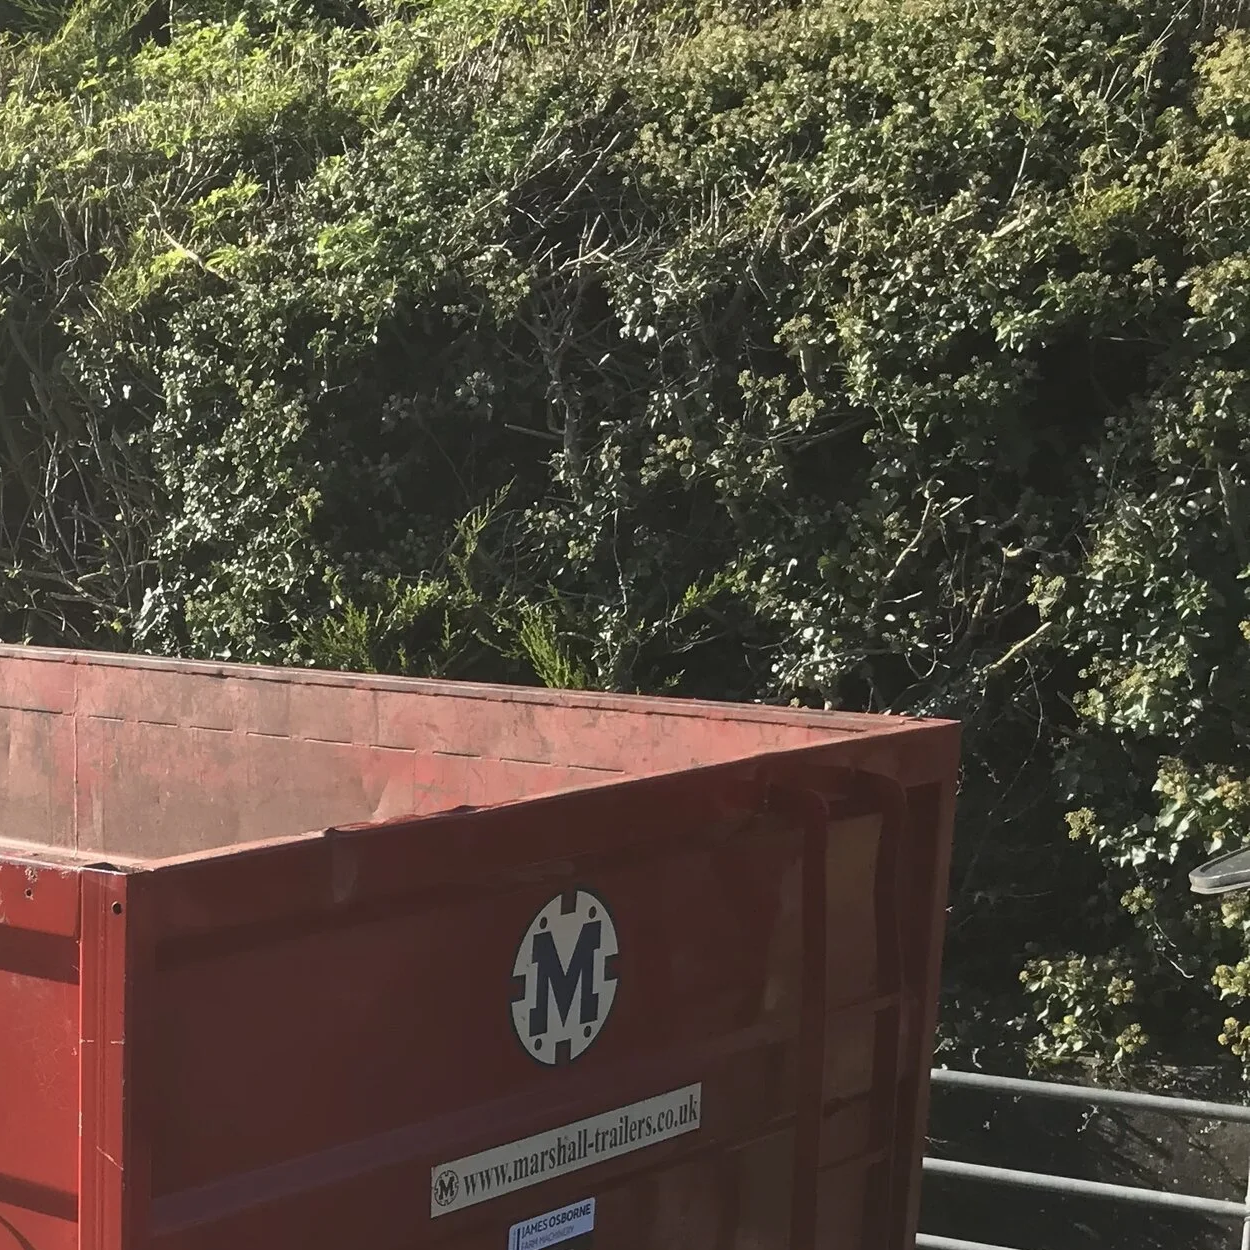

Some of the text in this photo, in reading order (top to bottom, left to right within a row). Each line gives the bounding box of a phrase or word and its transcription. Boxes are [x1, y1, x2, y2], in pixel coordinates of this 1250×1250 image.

[529, 919, 602, 1037] M
[463, 1094, 698, 1197] www.marshall-trailers.co.uk
[522, 1203, 592, 1239] JAMES OSBORNE
